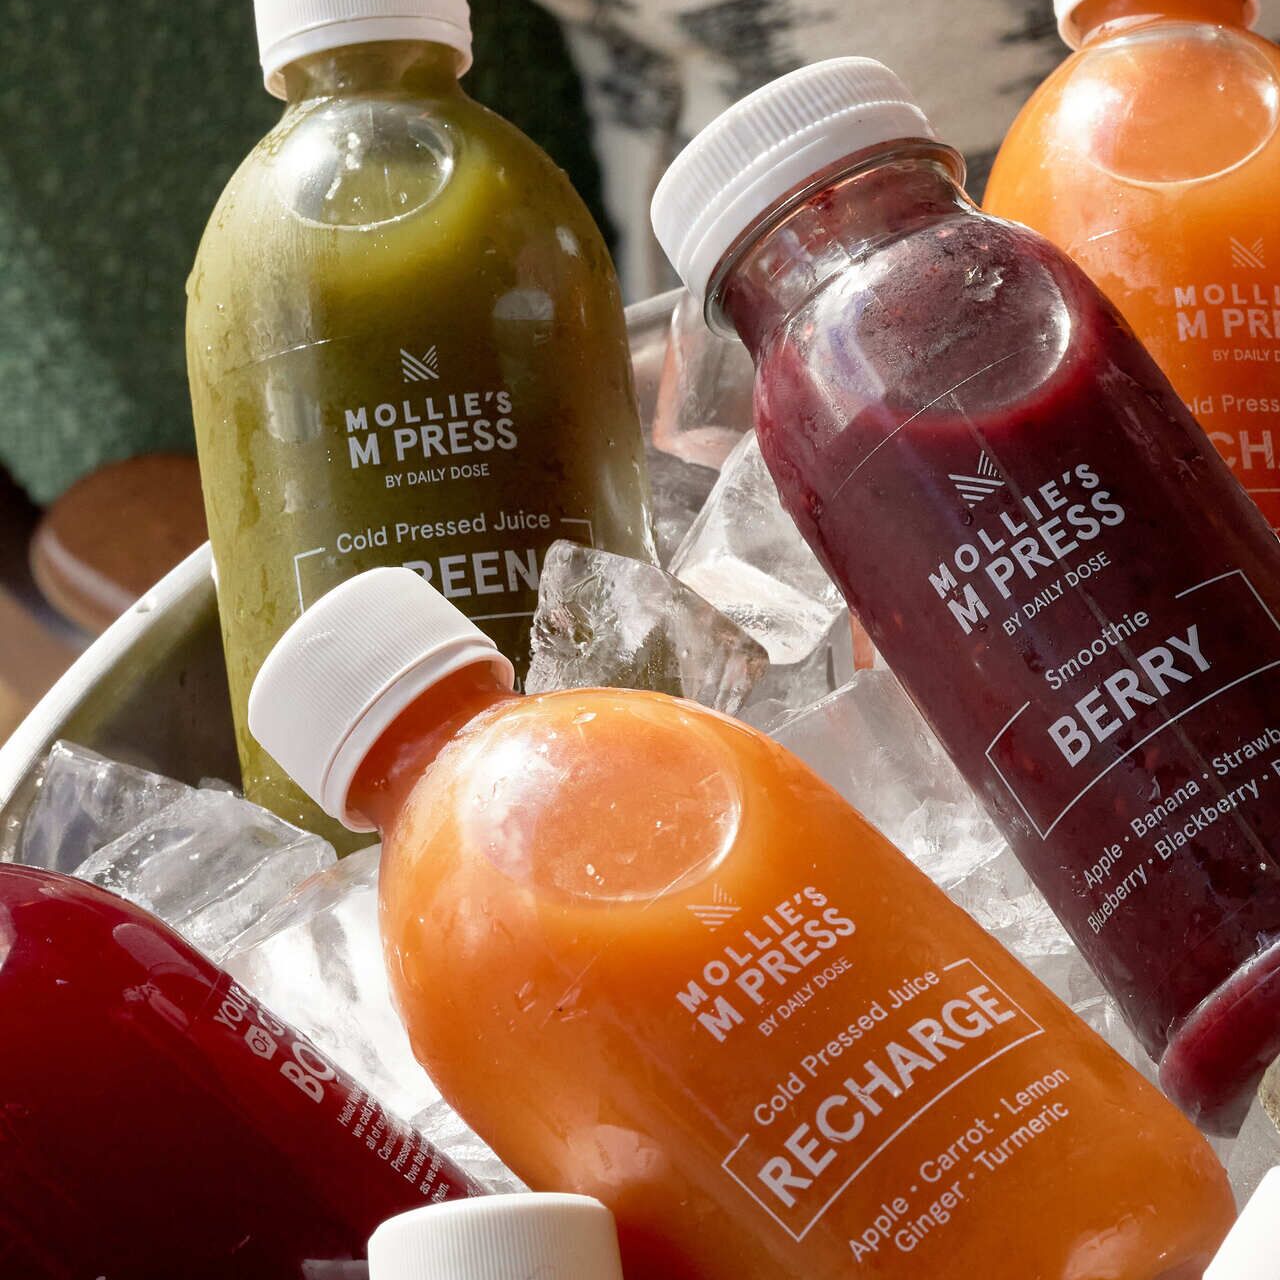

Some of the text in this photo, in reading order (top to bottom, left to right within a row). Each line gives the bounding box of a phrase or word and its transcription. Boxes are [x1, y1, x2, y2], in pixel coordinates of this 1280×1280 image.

[1177, 311, 1209, 341] M
[1212, 349, 1229, 361] BY
[1233, 349, 1270, 363] DAILY
[344, 391, 512, 433] MOLLIE'S
[347, 418, 518, 469] M PRESS
[384, 463, 490, 489] BY DAILY DOSE
[336, 510, 550, 555] Cold Pressed Juice
[928, 463, 1101, 600] MOLLIE'S
[945, 491, 1125, 636] M PRESS
[1001, 551, 1112, 637] BY DAILY DOSE
[1044, 606, 1150, 691] Smoothie
[1047, 623, 1212, 768] BERRY
[1082, 842, 1124, 888] Apple
[1130, 779, 1200, 838] Banana
[1087, 863, 1148, 935] Blueberry
[1154, 777, 1261, 862] Blackberry
[676, 885, 829, 1013] MOLLIE'S
[696, 907, 857, 1043] M PRESS
[757, 956, 853, 1037] BY DAILY DOSE
[252, 1031, 271, 1054] OF
[753, 967, 941, 1127] Cold Pressed Juice
[356, 1107, 373, 1125] cold
[757, 984, 1017, 1209] RECHARGE
[847, 1066, 1070, 1263] Apple Carrot Lemon
[893, 1099, 1070, 1255] Ginger Turmeric
